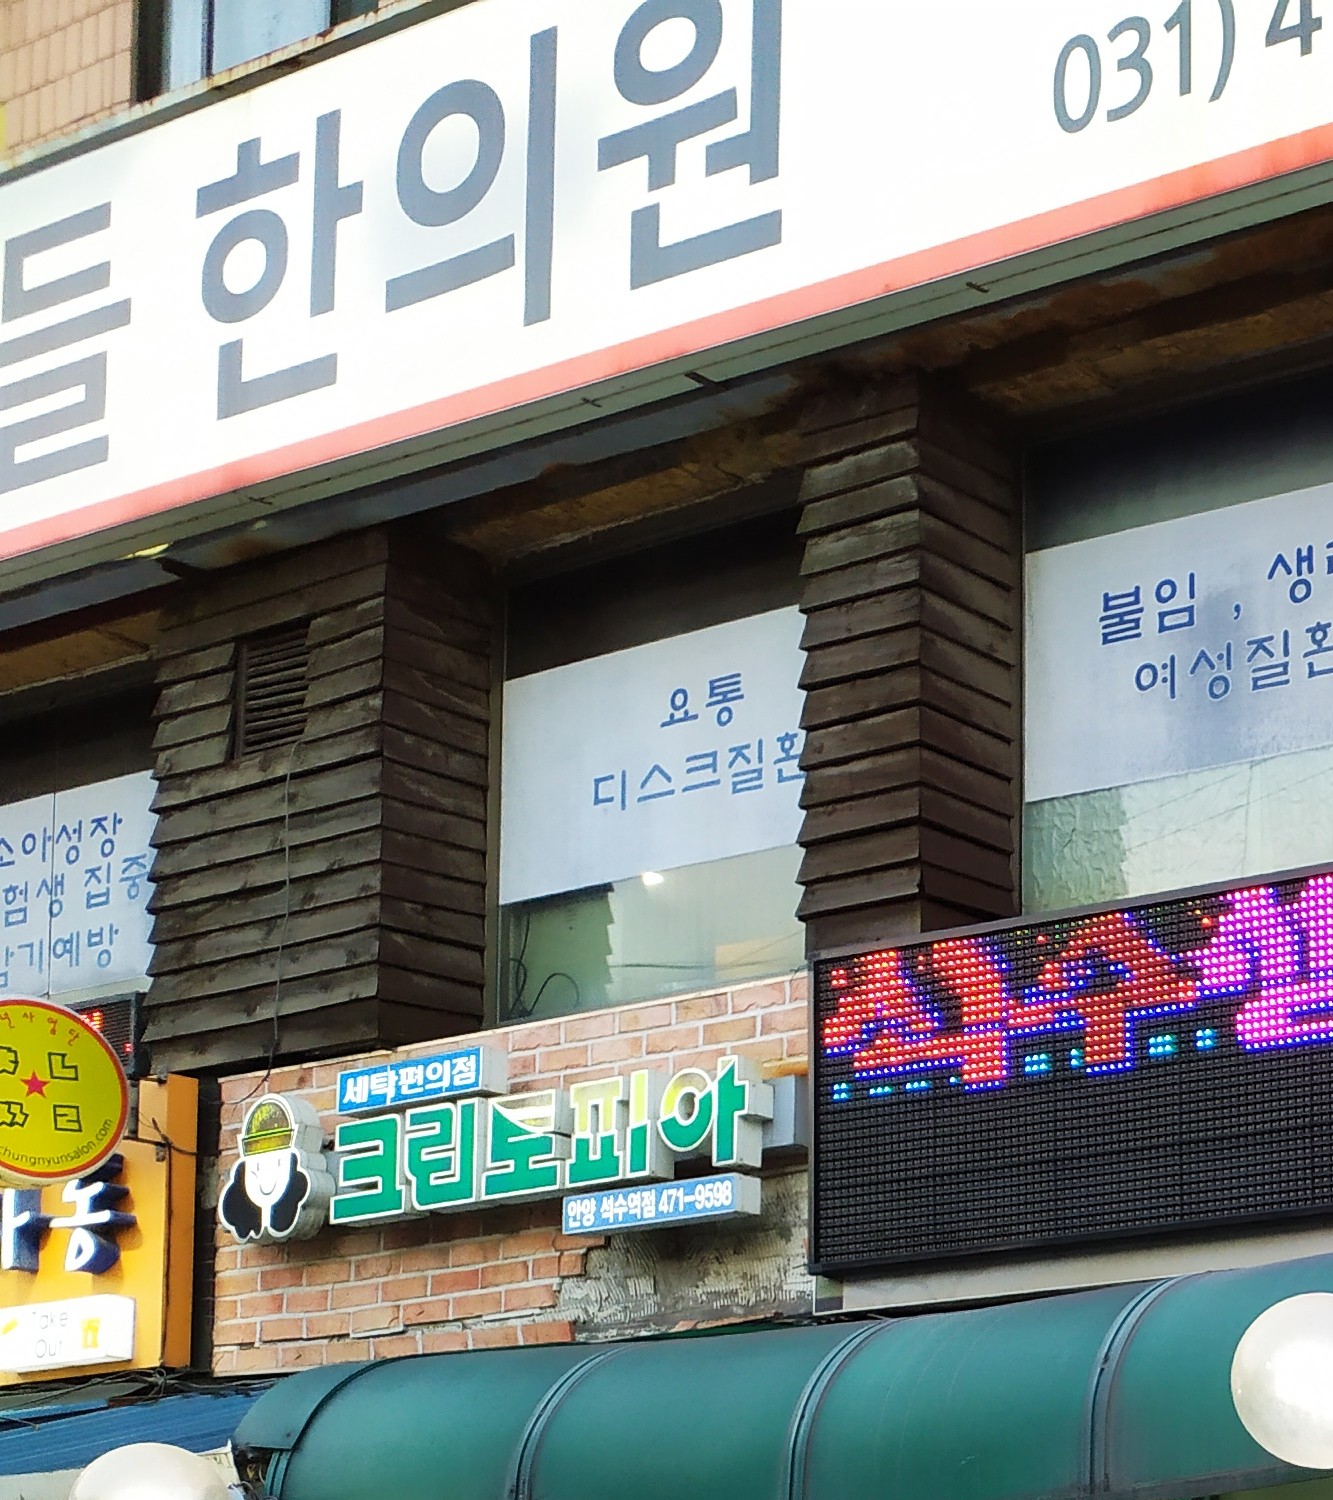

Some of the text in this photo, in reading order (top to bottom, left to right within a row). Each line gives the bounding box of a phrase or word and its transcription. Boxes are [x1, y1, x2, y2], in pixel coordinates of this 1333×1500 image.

[195, 0, 783, 420] 한의원
[1099, 572, 1196, 645] 불임
[660, 672, 744, 727] 요통
[84, 853, 150, 910] 집중
[342, 1054, 477, 1105] 세탁편의점
[329, 1055, 750, 1225] 크린토피아
[566, 1179, 733, 1229] 안양 석수역점 471-9598
